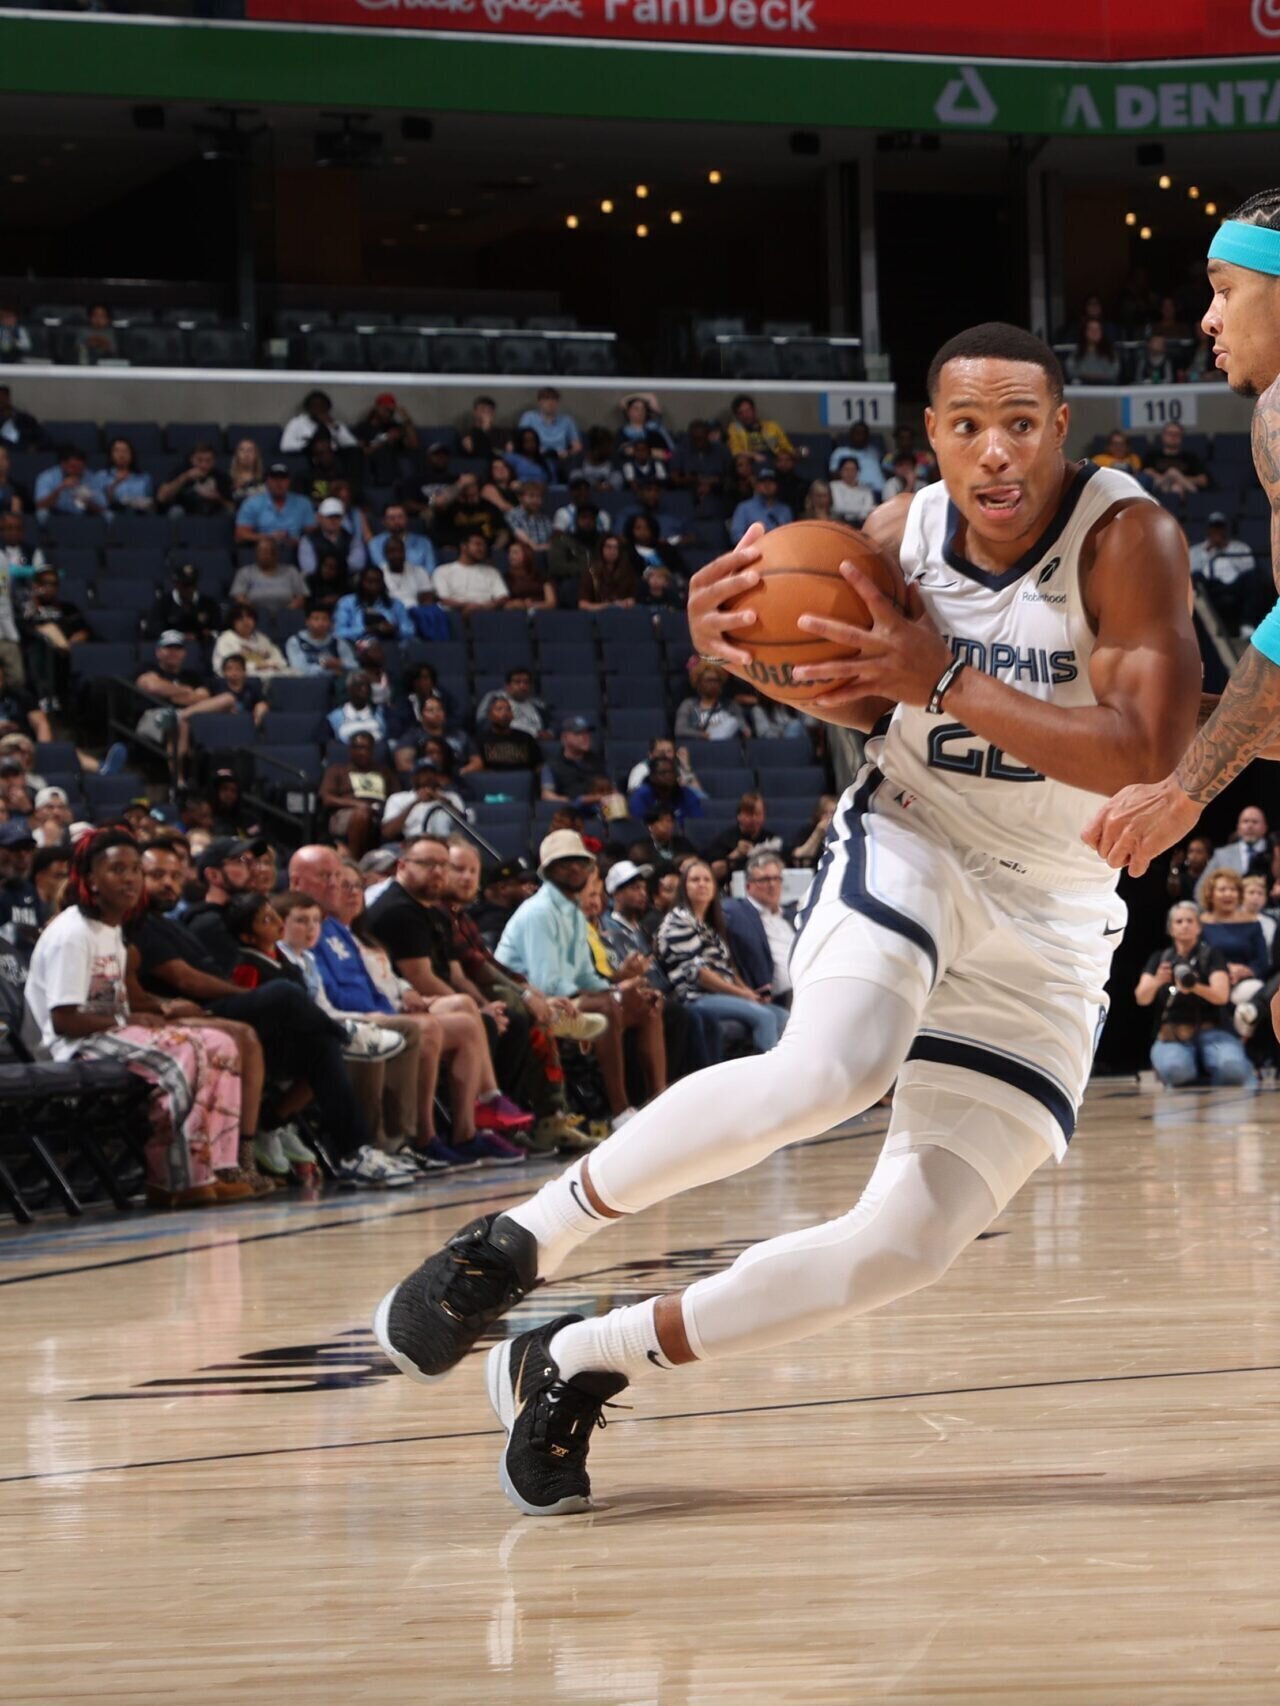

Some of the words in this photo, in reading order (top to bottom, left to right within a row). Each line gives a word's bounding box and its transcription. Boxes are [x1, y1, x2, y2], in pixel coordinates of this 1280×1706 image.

[842, 399, 879, 421] 111
[1143, 399, 1182, 422] 110
[1021, 591, 1067, 604] Robinhood
[942, 635, 1079, 685] MPHIS
